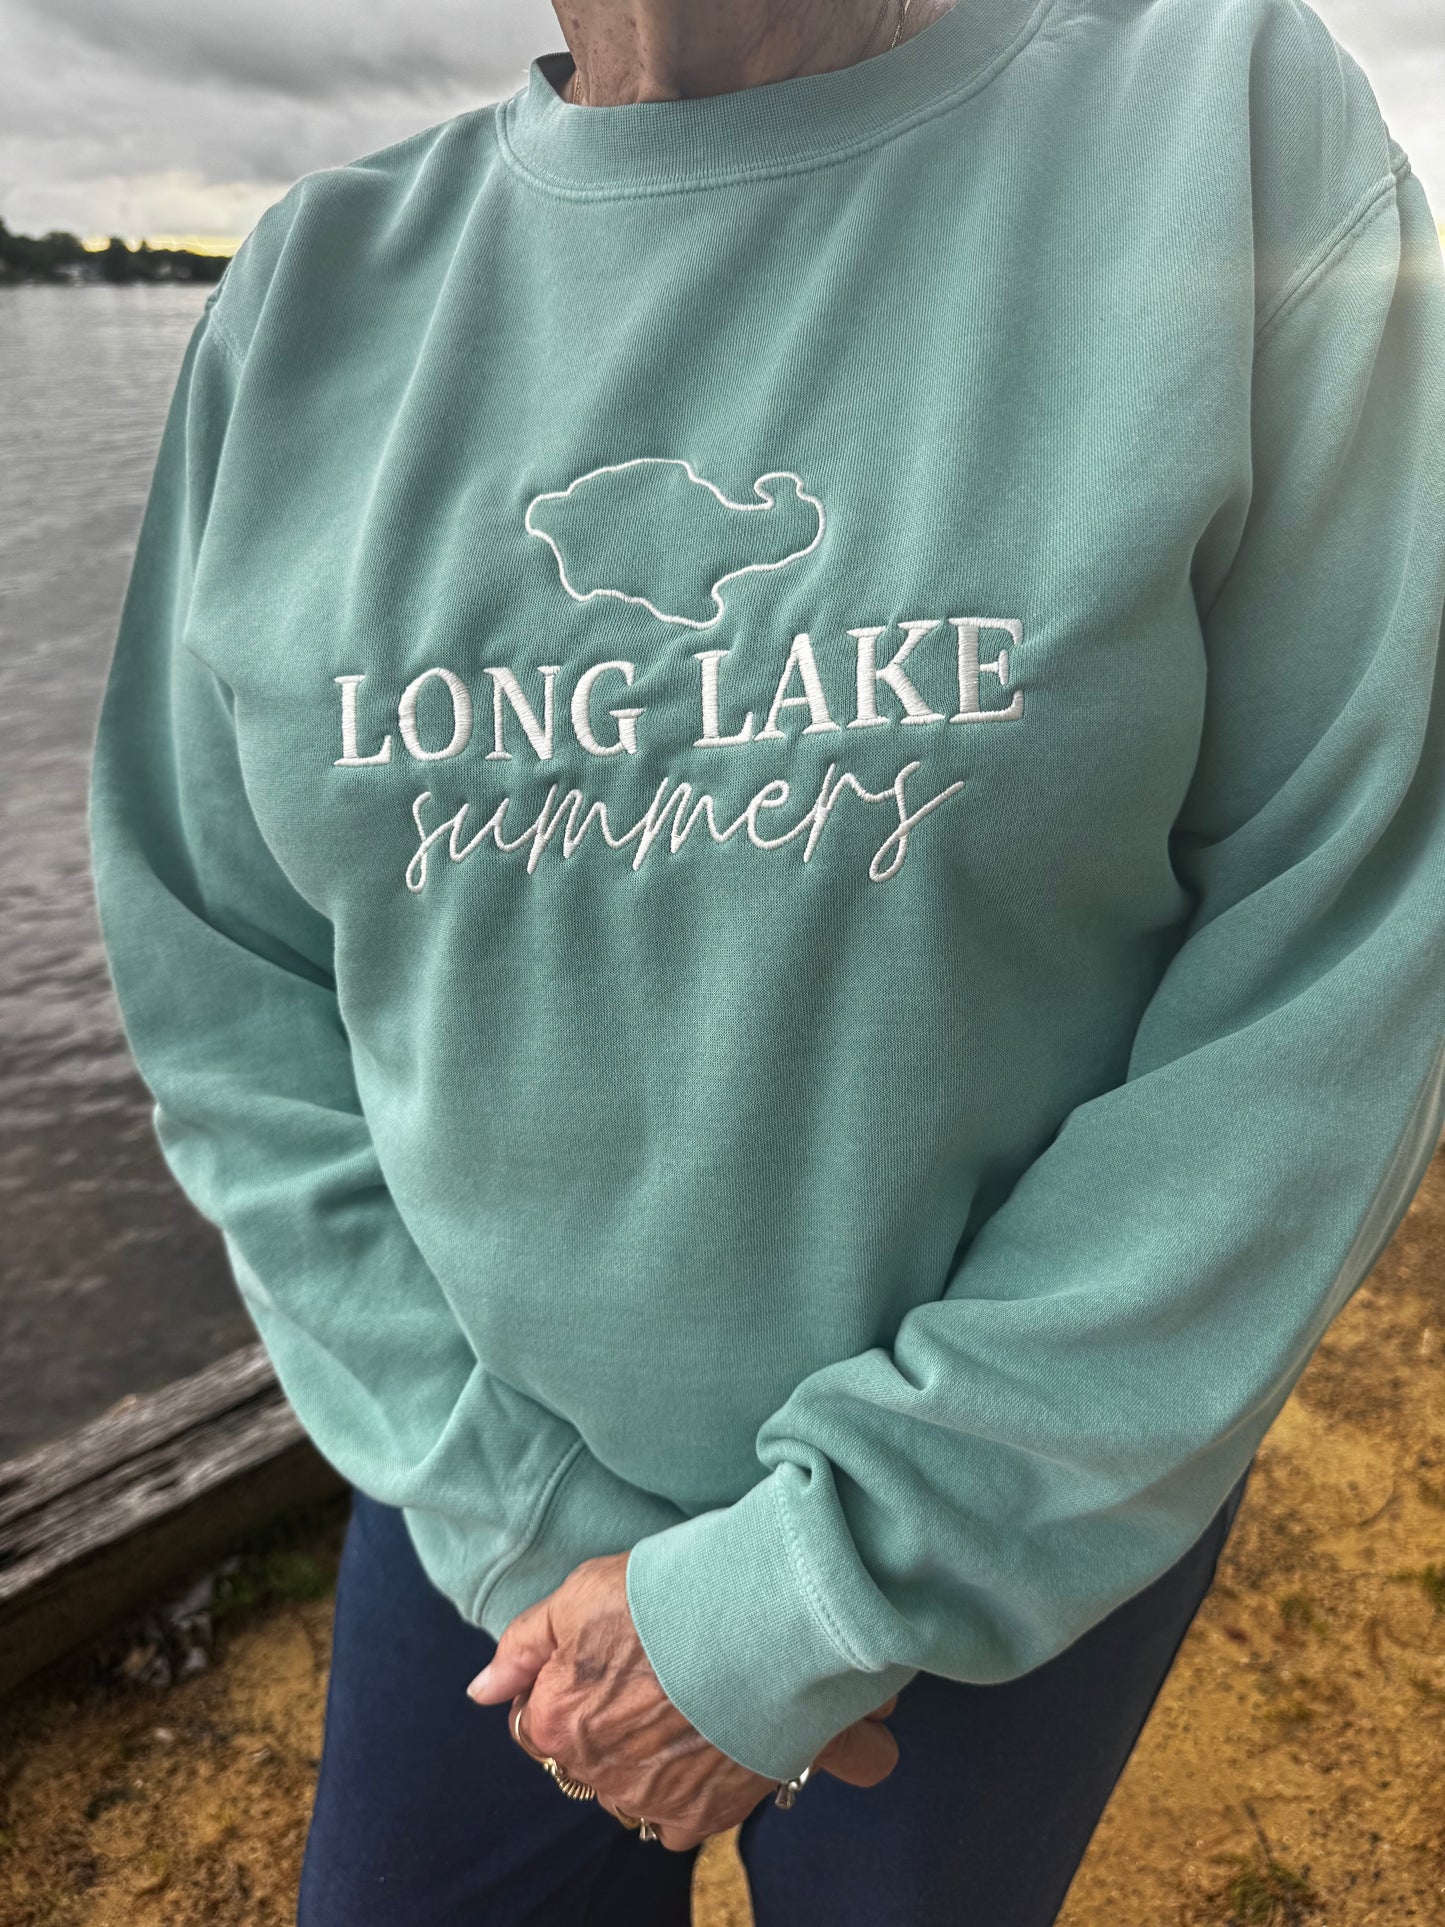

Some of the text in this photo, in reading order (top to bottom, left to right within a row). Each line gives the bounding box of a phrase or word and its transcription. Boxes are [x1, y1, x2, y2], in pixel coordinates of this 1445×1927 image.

[333, 616, 1024, 768] LONG LAKE
[405, 760, 964, 892] summers
